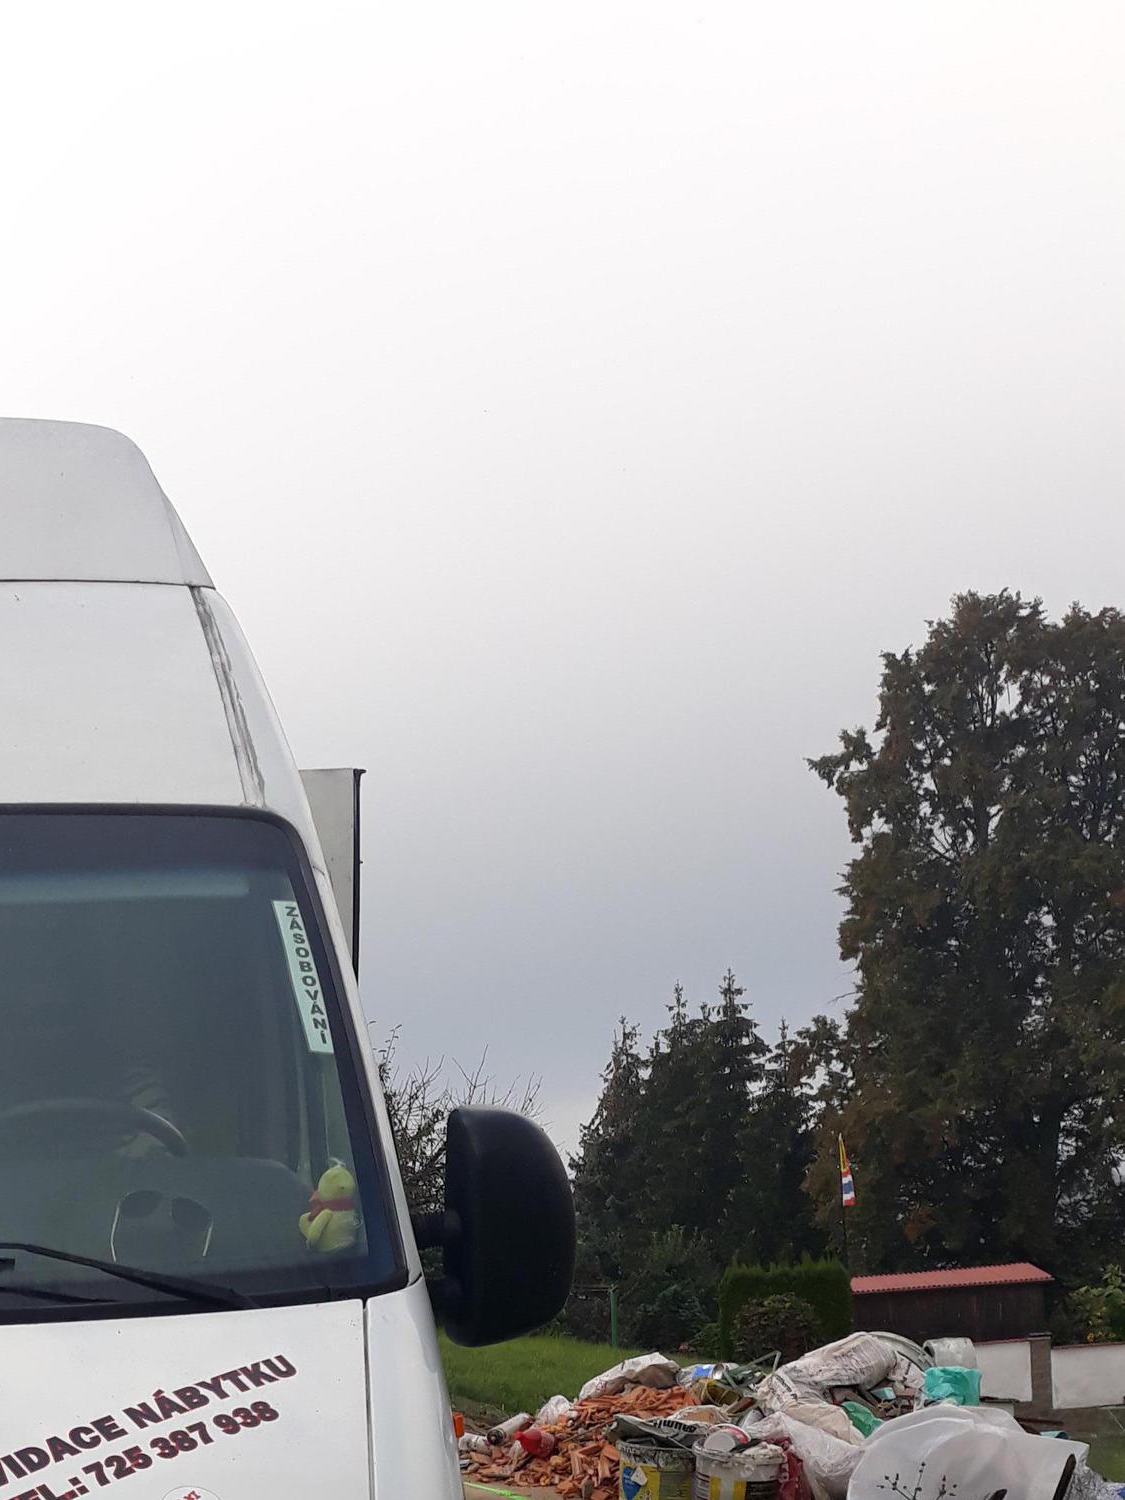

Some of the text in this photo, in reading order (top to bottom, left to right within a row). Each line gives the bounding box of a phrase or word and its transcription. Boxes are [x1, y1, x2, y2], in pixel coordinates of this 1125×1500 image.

[122, 1354, 297, 1430] NÁBYTKU
[81, 1445, 153, 1487] 725
[149, 1421, 214, 1459] 387
[212, 1401, 279, 1435] 938
